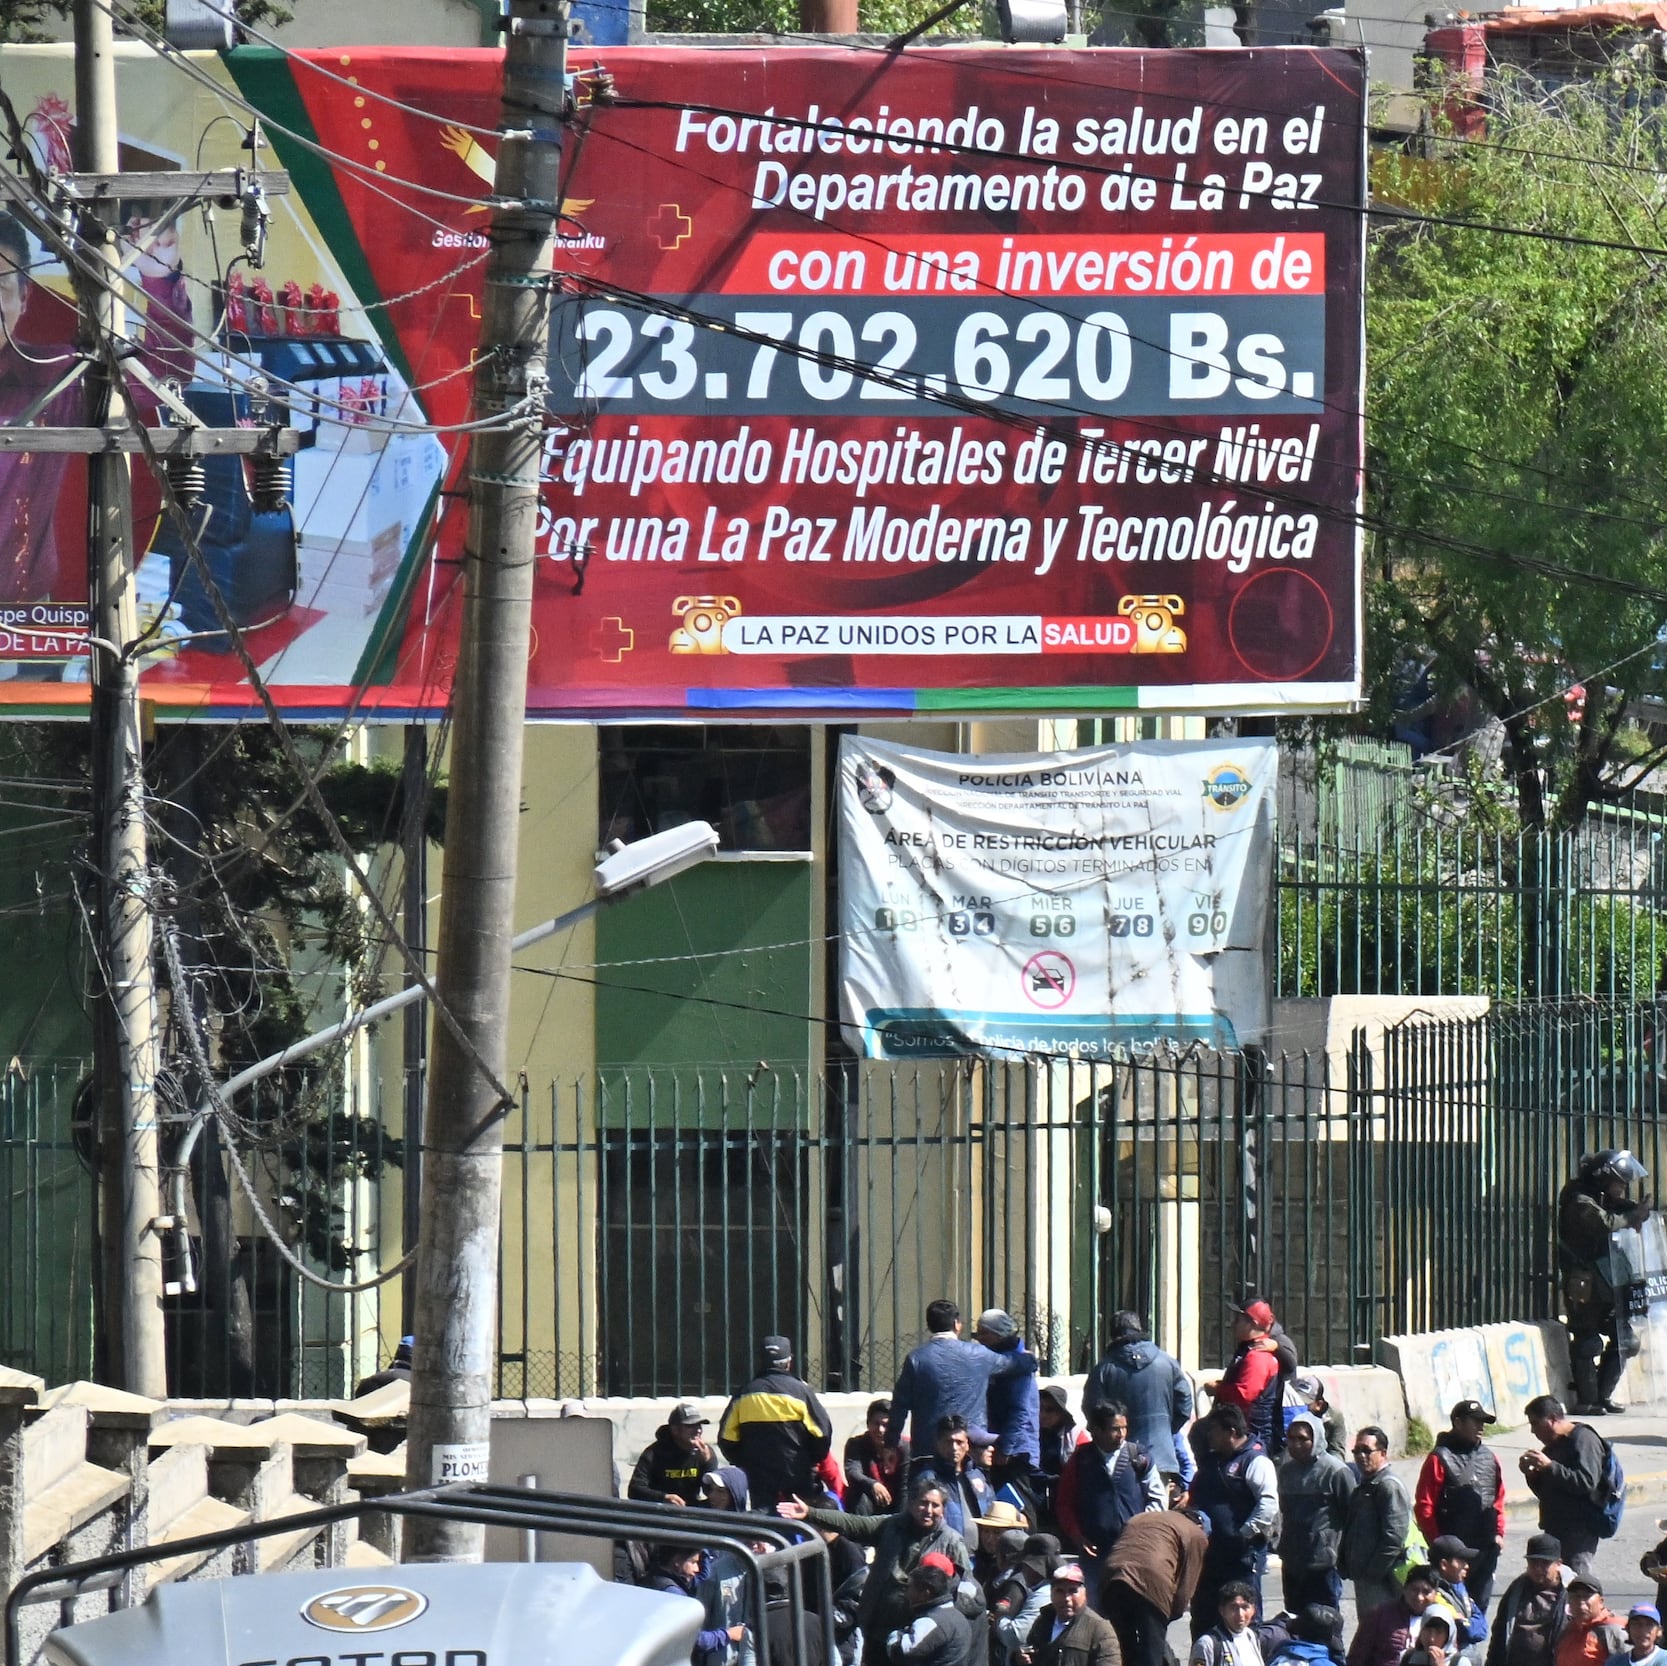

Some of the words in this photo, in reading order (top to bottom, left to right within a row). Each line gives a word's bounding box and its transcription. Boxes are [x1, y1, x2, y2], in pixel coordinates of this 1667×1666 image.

[674, 106, 1006, 155] Fortaleciendo
[1018, 106, 1060, 154] la
[1071, 106, 1201, 154] salud
[1213, 121, 1270, 154] en
[1282, 106, 1323, 154] el
[751, 162, 1086, 212] Departamento
[1099, 162, 1155, 210] de
[1169, 163, 1224, 210] La
[1242, 163, 1322, 211] Paz
[768, 250, 868, 291] con
[882, 250, 977, 291] una
[996, 235, 1236, 292] inversión
[1250, 235, 1312, 291] de
[573, 310, 1133, 403] 23.702.620
[1167, 313, 1316, 400] Bs.
[540, 426, 770, 498] Equipando
[779, 424, 1005, 496] Hospitales
[1013, 424, 1065, 484] de
[1075, 426, 1207, 484] Tercer
[1217, 424, 1321, 482] Nivel
[532, 505, 592, 563] Por
[604, 522, 687, 562] una
[697, 507, 748, 562] La
[757, 507, 833, 563] Paz
[844, 504, 1031, 563] Moderna
[1033, 520, 1068, 576] y
[1075, 502, 1318, 575] Tecnológica
[31, 606, 89, 627] Quisp
[740, 624, 774, 646] LA
[781, 624, 831, 646] PAZ
[838, 623, 936, 646] UNIDOS
[945, 623, 998, 646] POR
[1005, 623, 1039, 646] LA
[1044, 622, 1132, 647] SALUD
[1040, 770, 1143, 787] BOLIVIANA
[1059, 789, 1111, 799] TRANSPORTE
[1119, 789, 1165, 798] SEGURIDAD
[1165, 788, 1183, 797] VIAL
[1121, 801, 1132, 810] LA
[1133, 801, 1149, 810] PAZ
[884, 827, 935, 849] ÁREA
[942, 833, 967, 849] DE
[973, 829, 1105, 852] RESTRICCIÓN
[1109, 833, 1217, 851] VEHICULAR
[888, 854, 956, 872] PLACAS
[1071, 857, 1180, 874] TERMINADOS
[952, 894, 993, 910] MAR
[1113, 897, 1145, 911] JUE
[1194, 896, 1222, 911] VIE
